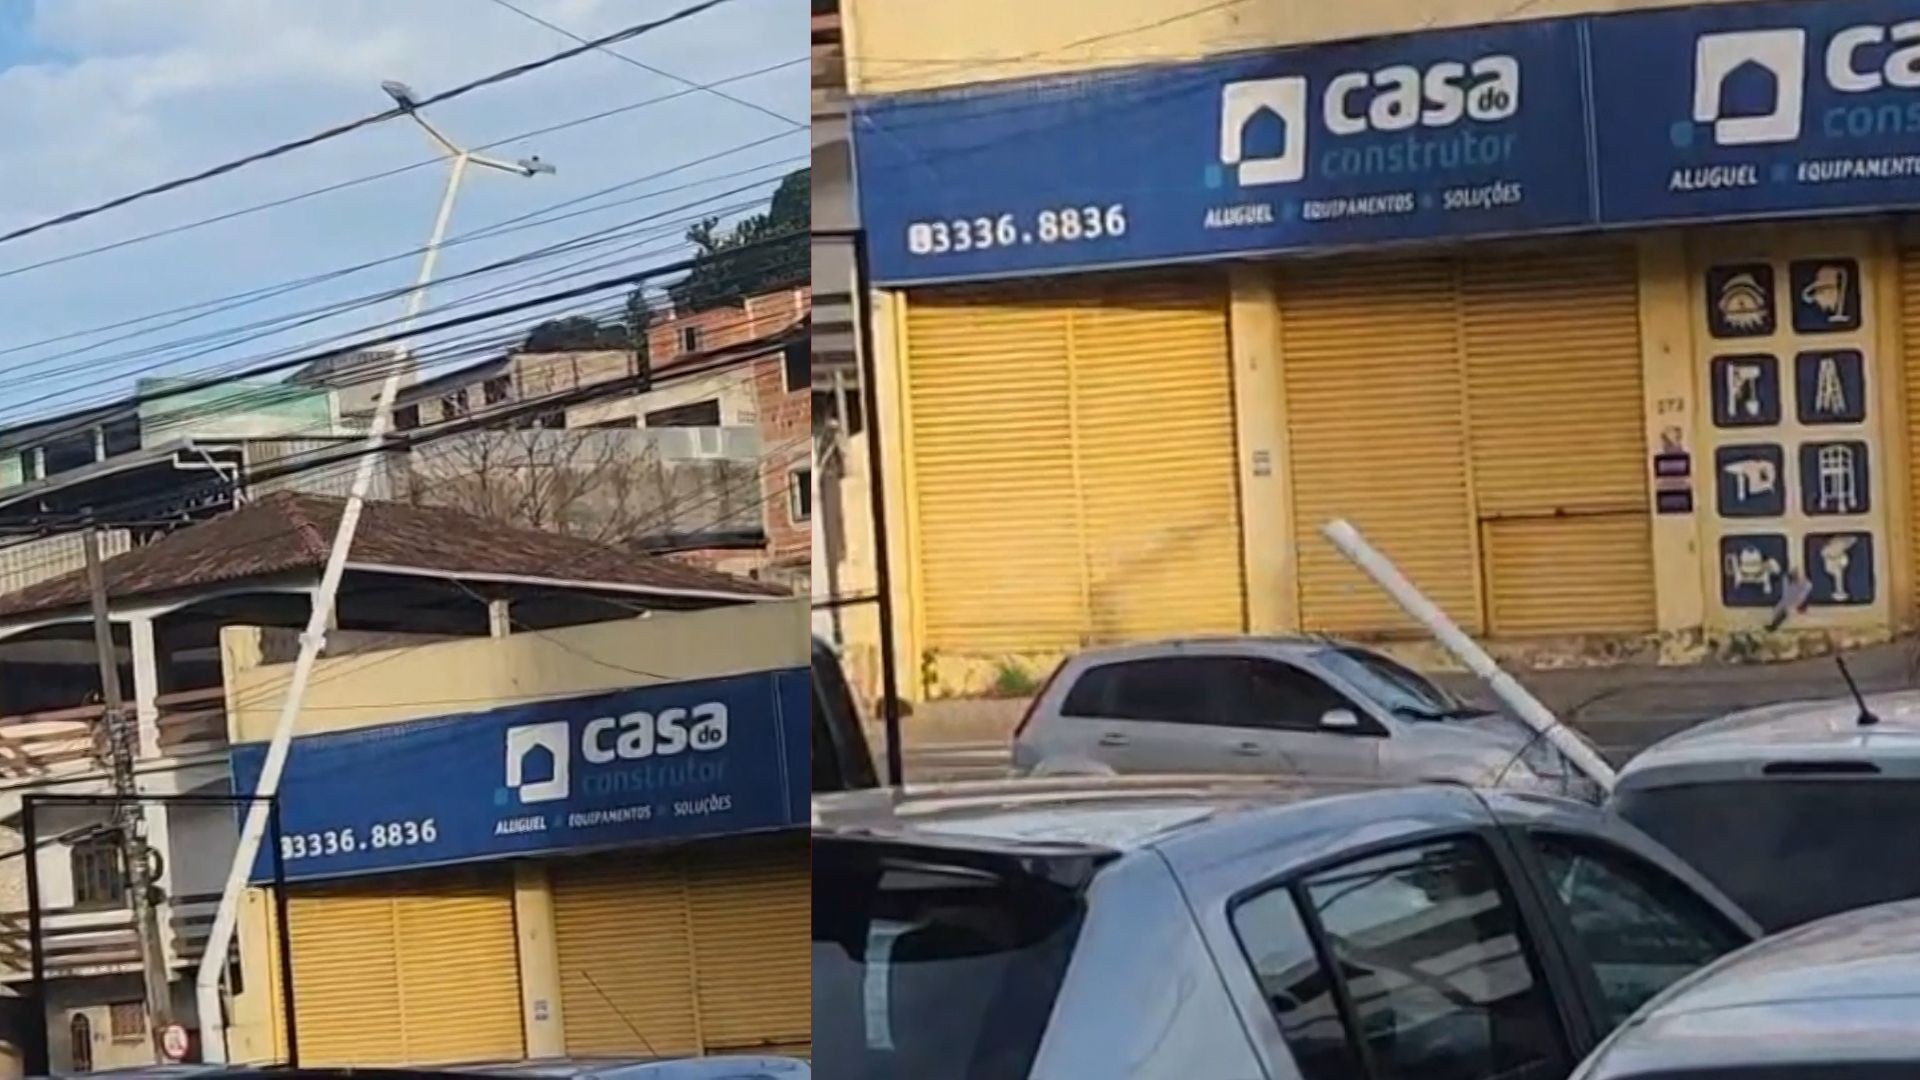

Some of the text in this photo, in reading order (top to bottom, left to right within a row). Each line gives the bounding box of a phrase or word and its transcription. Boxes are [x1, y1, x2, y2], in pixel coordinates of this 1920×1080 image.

[1323, 55, 1519, 135] casa
[1478, 86, 1509, 111] do
[1322, 132, 1517, 176] construtor
[1669, 165, 1759, 191] ALUGUEL
[1204, 181, 1522, 229] ALUGUEL EQUIPAMENTOS SOLUÇÕES
[582, 702, 728, 763] casa
[698, 726, 722, 743] do
[584, 758, 728, 793] construtor
[495, 795, 732, 835] ALUGUEL EQUIPAMENTOS SOLUÇÕES
